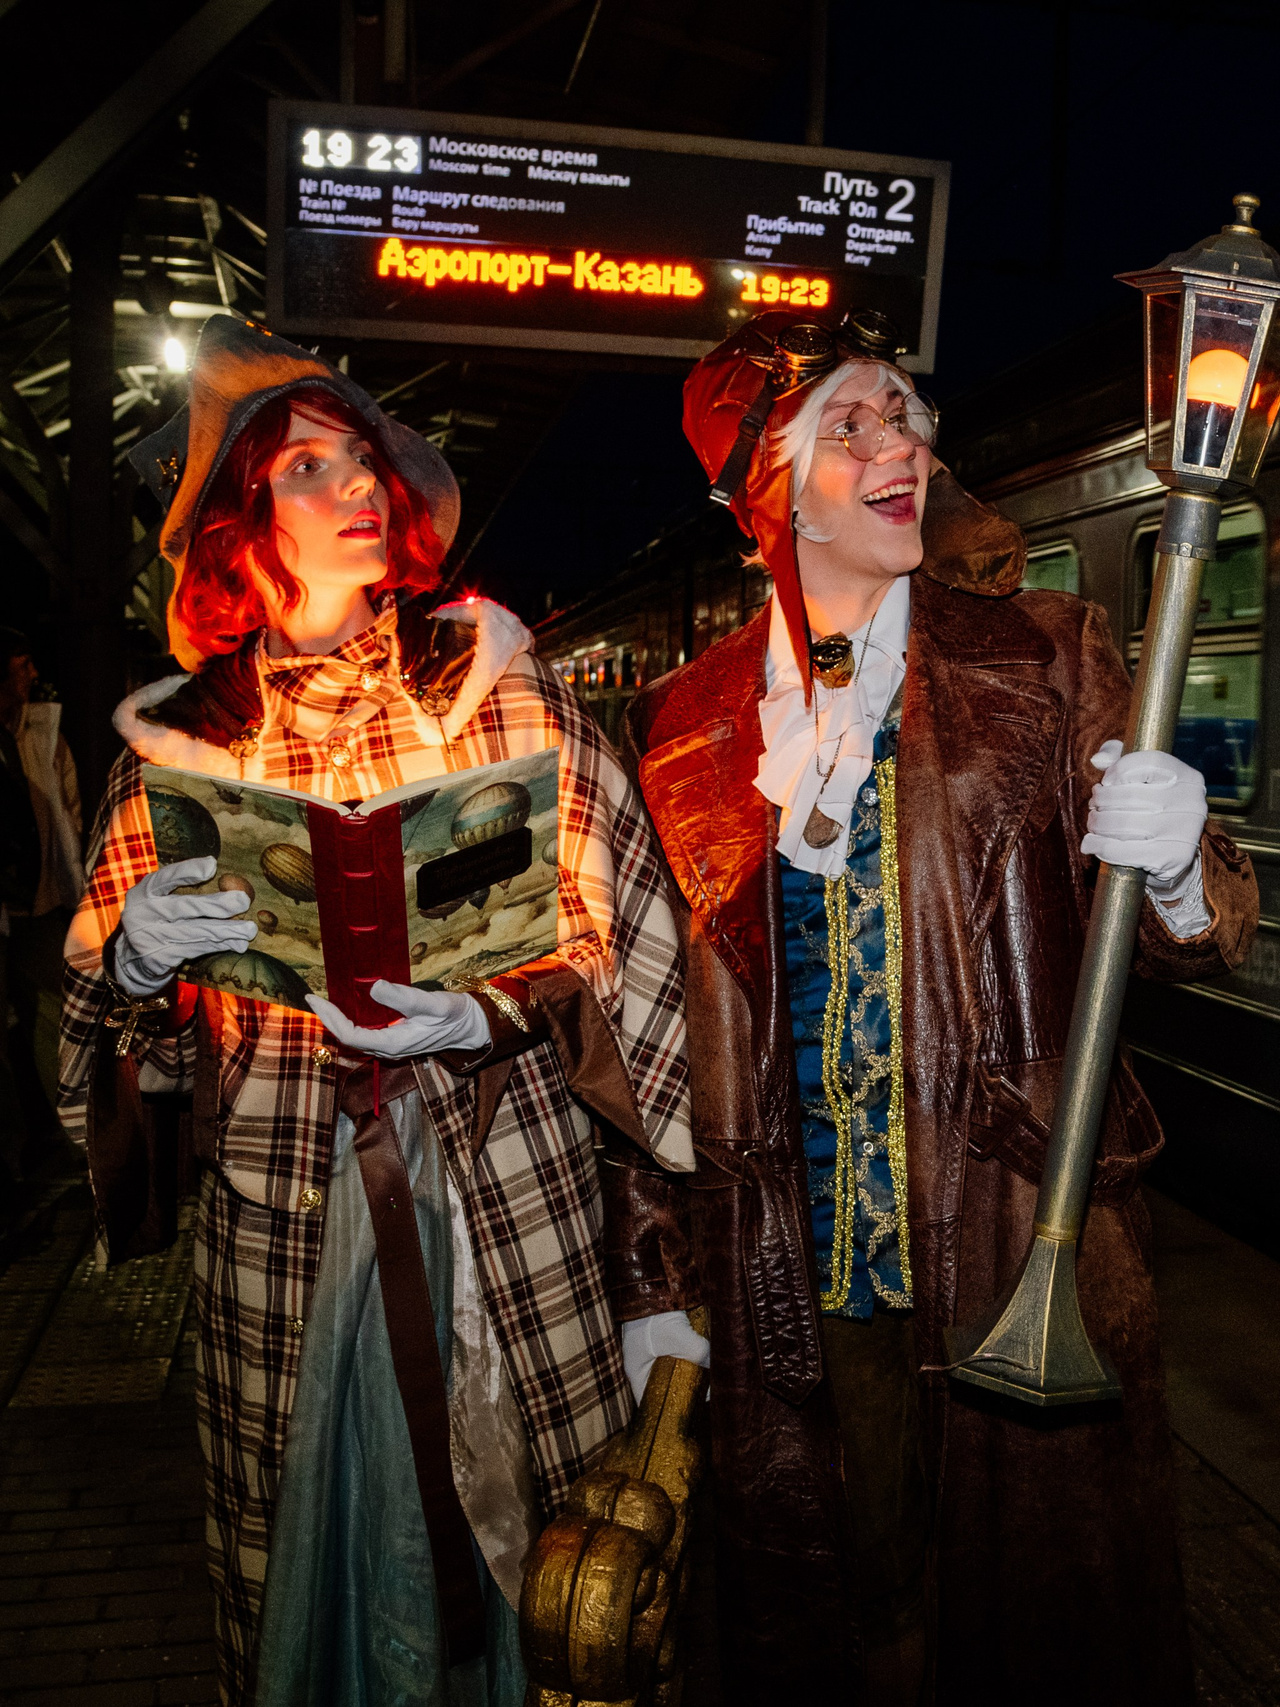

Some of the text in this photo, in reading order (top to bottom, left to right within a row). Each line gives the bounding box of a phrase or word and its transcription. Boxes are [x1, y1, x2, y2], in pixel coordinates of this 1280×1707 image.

[301, 128, 420, 173] 19 23
[428, 136, 599, 168] Московское время
[428, 158, 512, 178] Moscow time
[299, 177, 382, 201] № Поезда
[391, 184, 567, 214] Маршрут следования
[823, 170, 917, 223] Путь 2
[299, 195, 332, 211] Train
[391, 202, 428, 218] Route
[797, 195, 842, 216] Track
[746, 213, 826, 237] Прибытие
[846, 222, 915, 244] Отправл.
[745, 231, 782, 245] Arrival
[845, 238, 898, 255] Departure
[740, 274, 830, 307] 19:23
